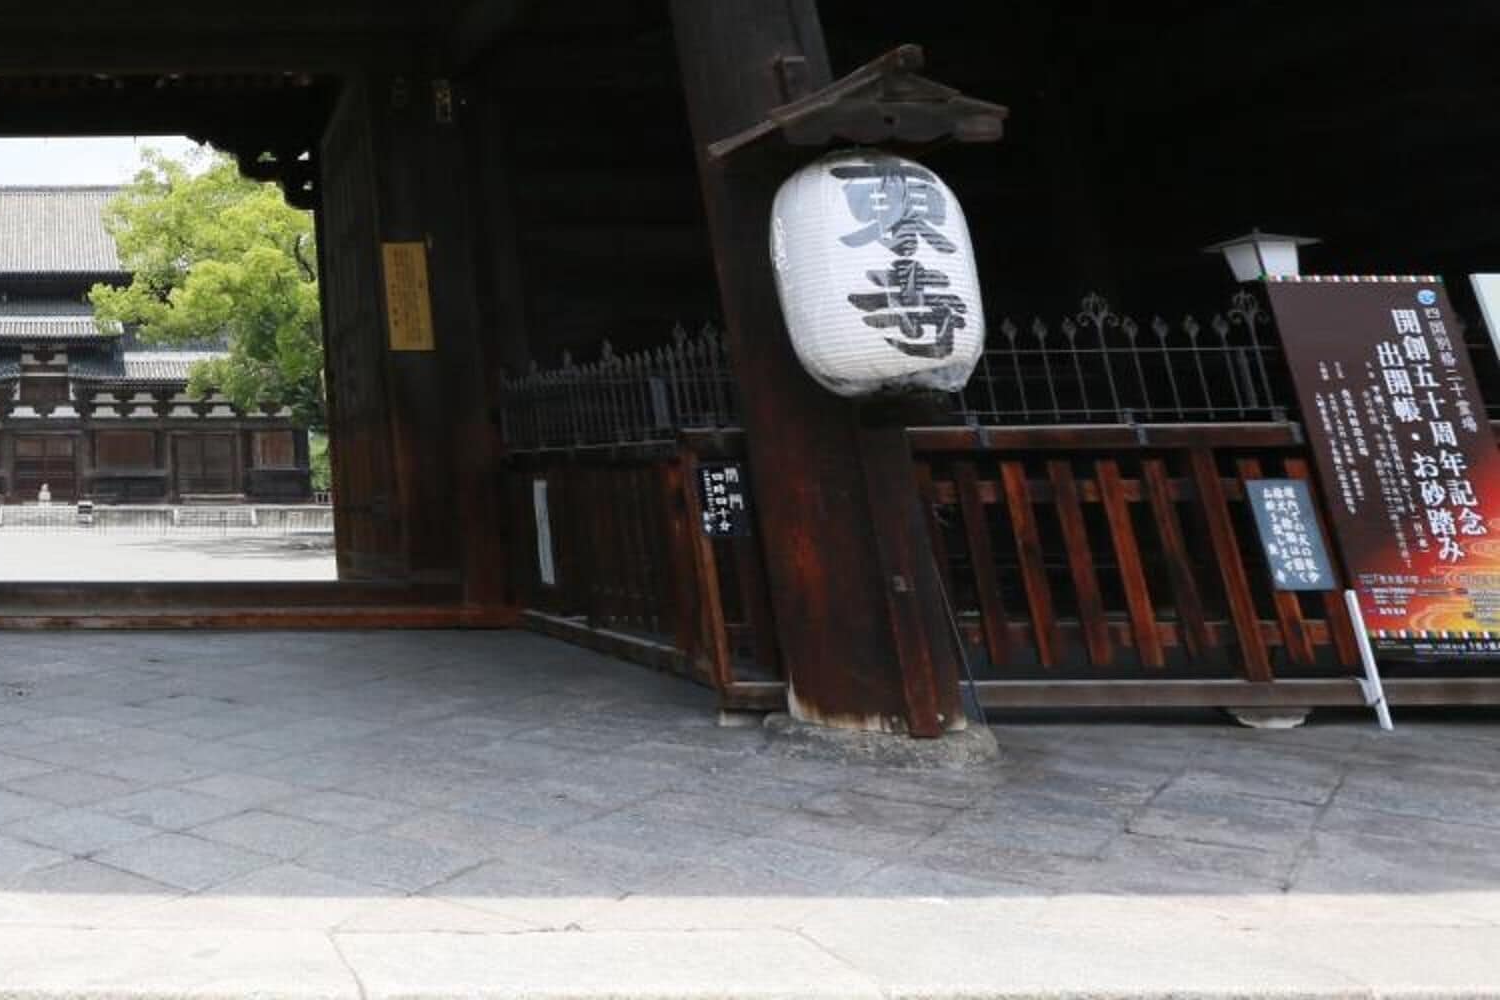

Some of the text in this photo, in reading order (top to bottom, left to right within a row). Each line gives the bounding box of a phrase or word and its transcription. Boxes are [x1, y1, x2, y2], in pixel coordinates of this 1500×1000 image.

[830, 158, 967, 360] 東寺
[1376, 339, 1465, 564] 出開帳・お砂踏み
[1391, 308, 1488, 536] 開創五十周年記念
